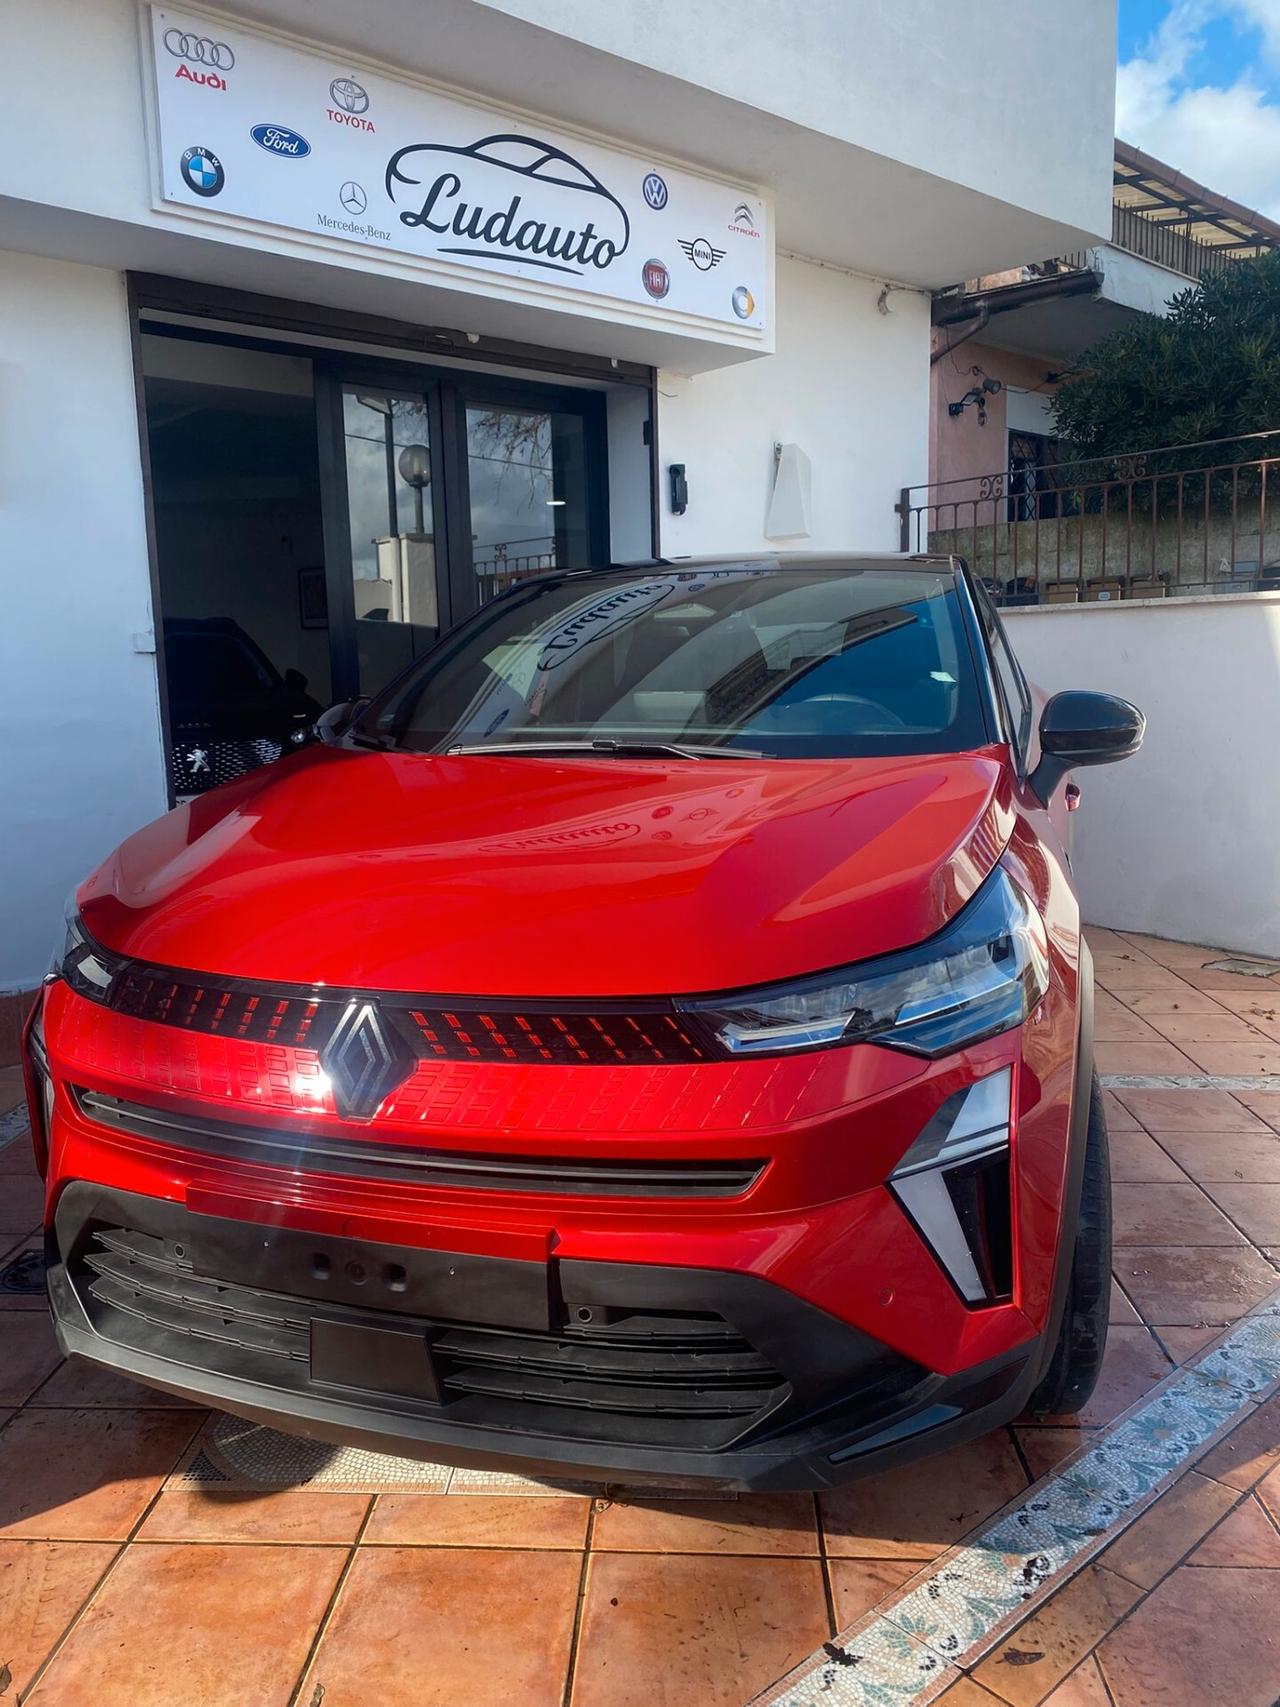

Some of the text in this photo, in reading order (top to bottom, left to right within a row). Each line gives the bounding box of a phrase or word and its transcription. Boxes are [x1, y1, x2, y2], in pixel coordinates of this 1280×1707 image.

[175, 64, 227, 91] Audi
[326, 109, 376, 133] TOYOTA
[262, 128, 299, 154] Ford
[184, 148, 220, 168] BMW
[317, 213, 391, 241] Mercedes-Benz
[399, 173, 616, 269] Ludauto
[694, 248, 711, 261] MINI
[650, 269, 665, 289] FIAT
